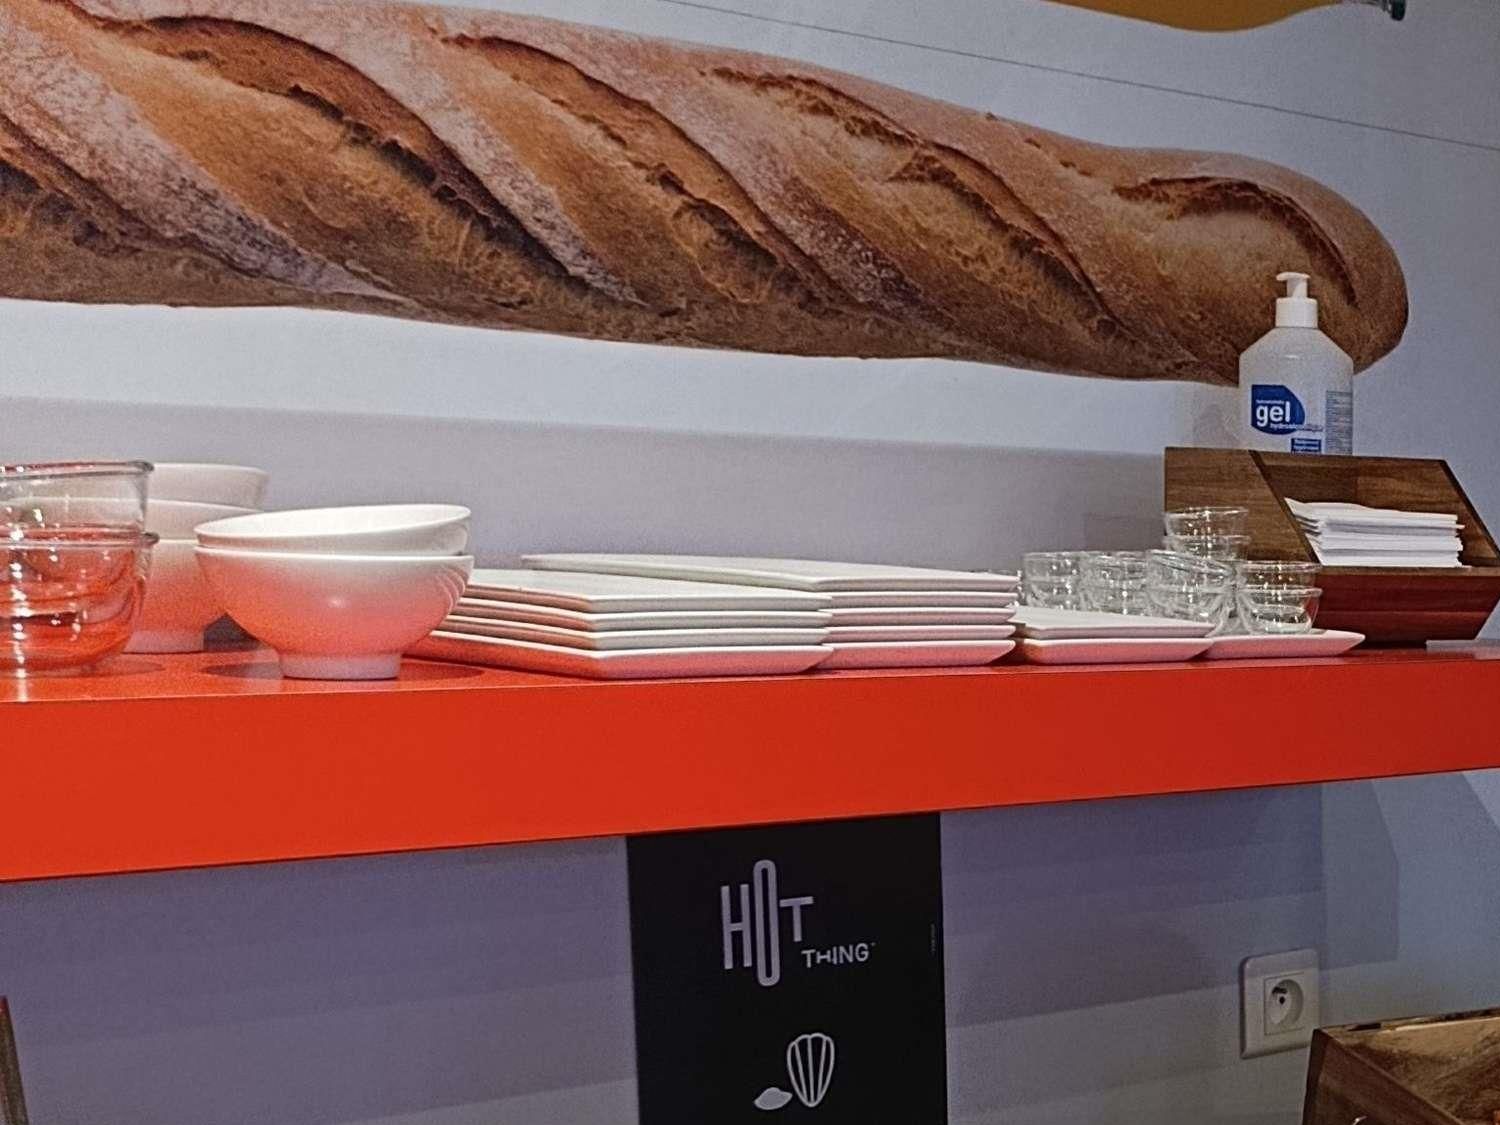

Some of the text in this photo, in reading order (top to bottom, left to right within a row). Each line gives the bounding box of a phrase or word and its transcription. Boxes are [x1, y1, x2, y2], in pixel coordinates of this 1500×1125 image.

[1256, 401, 1290, 427] gel
[721, 859, 814, 986] HOT
[802, 943, 869, 968] THING
